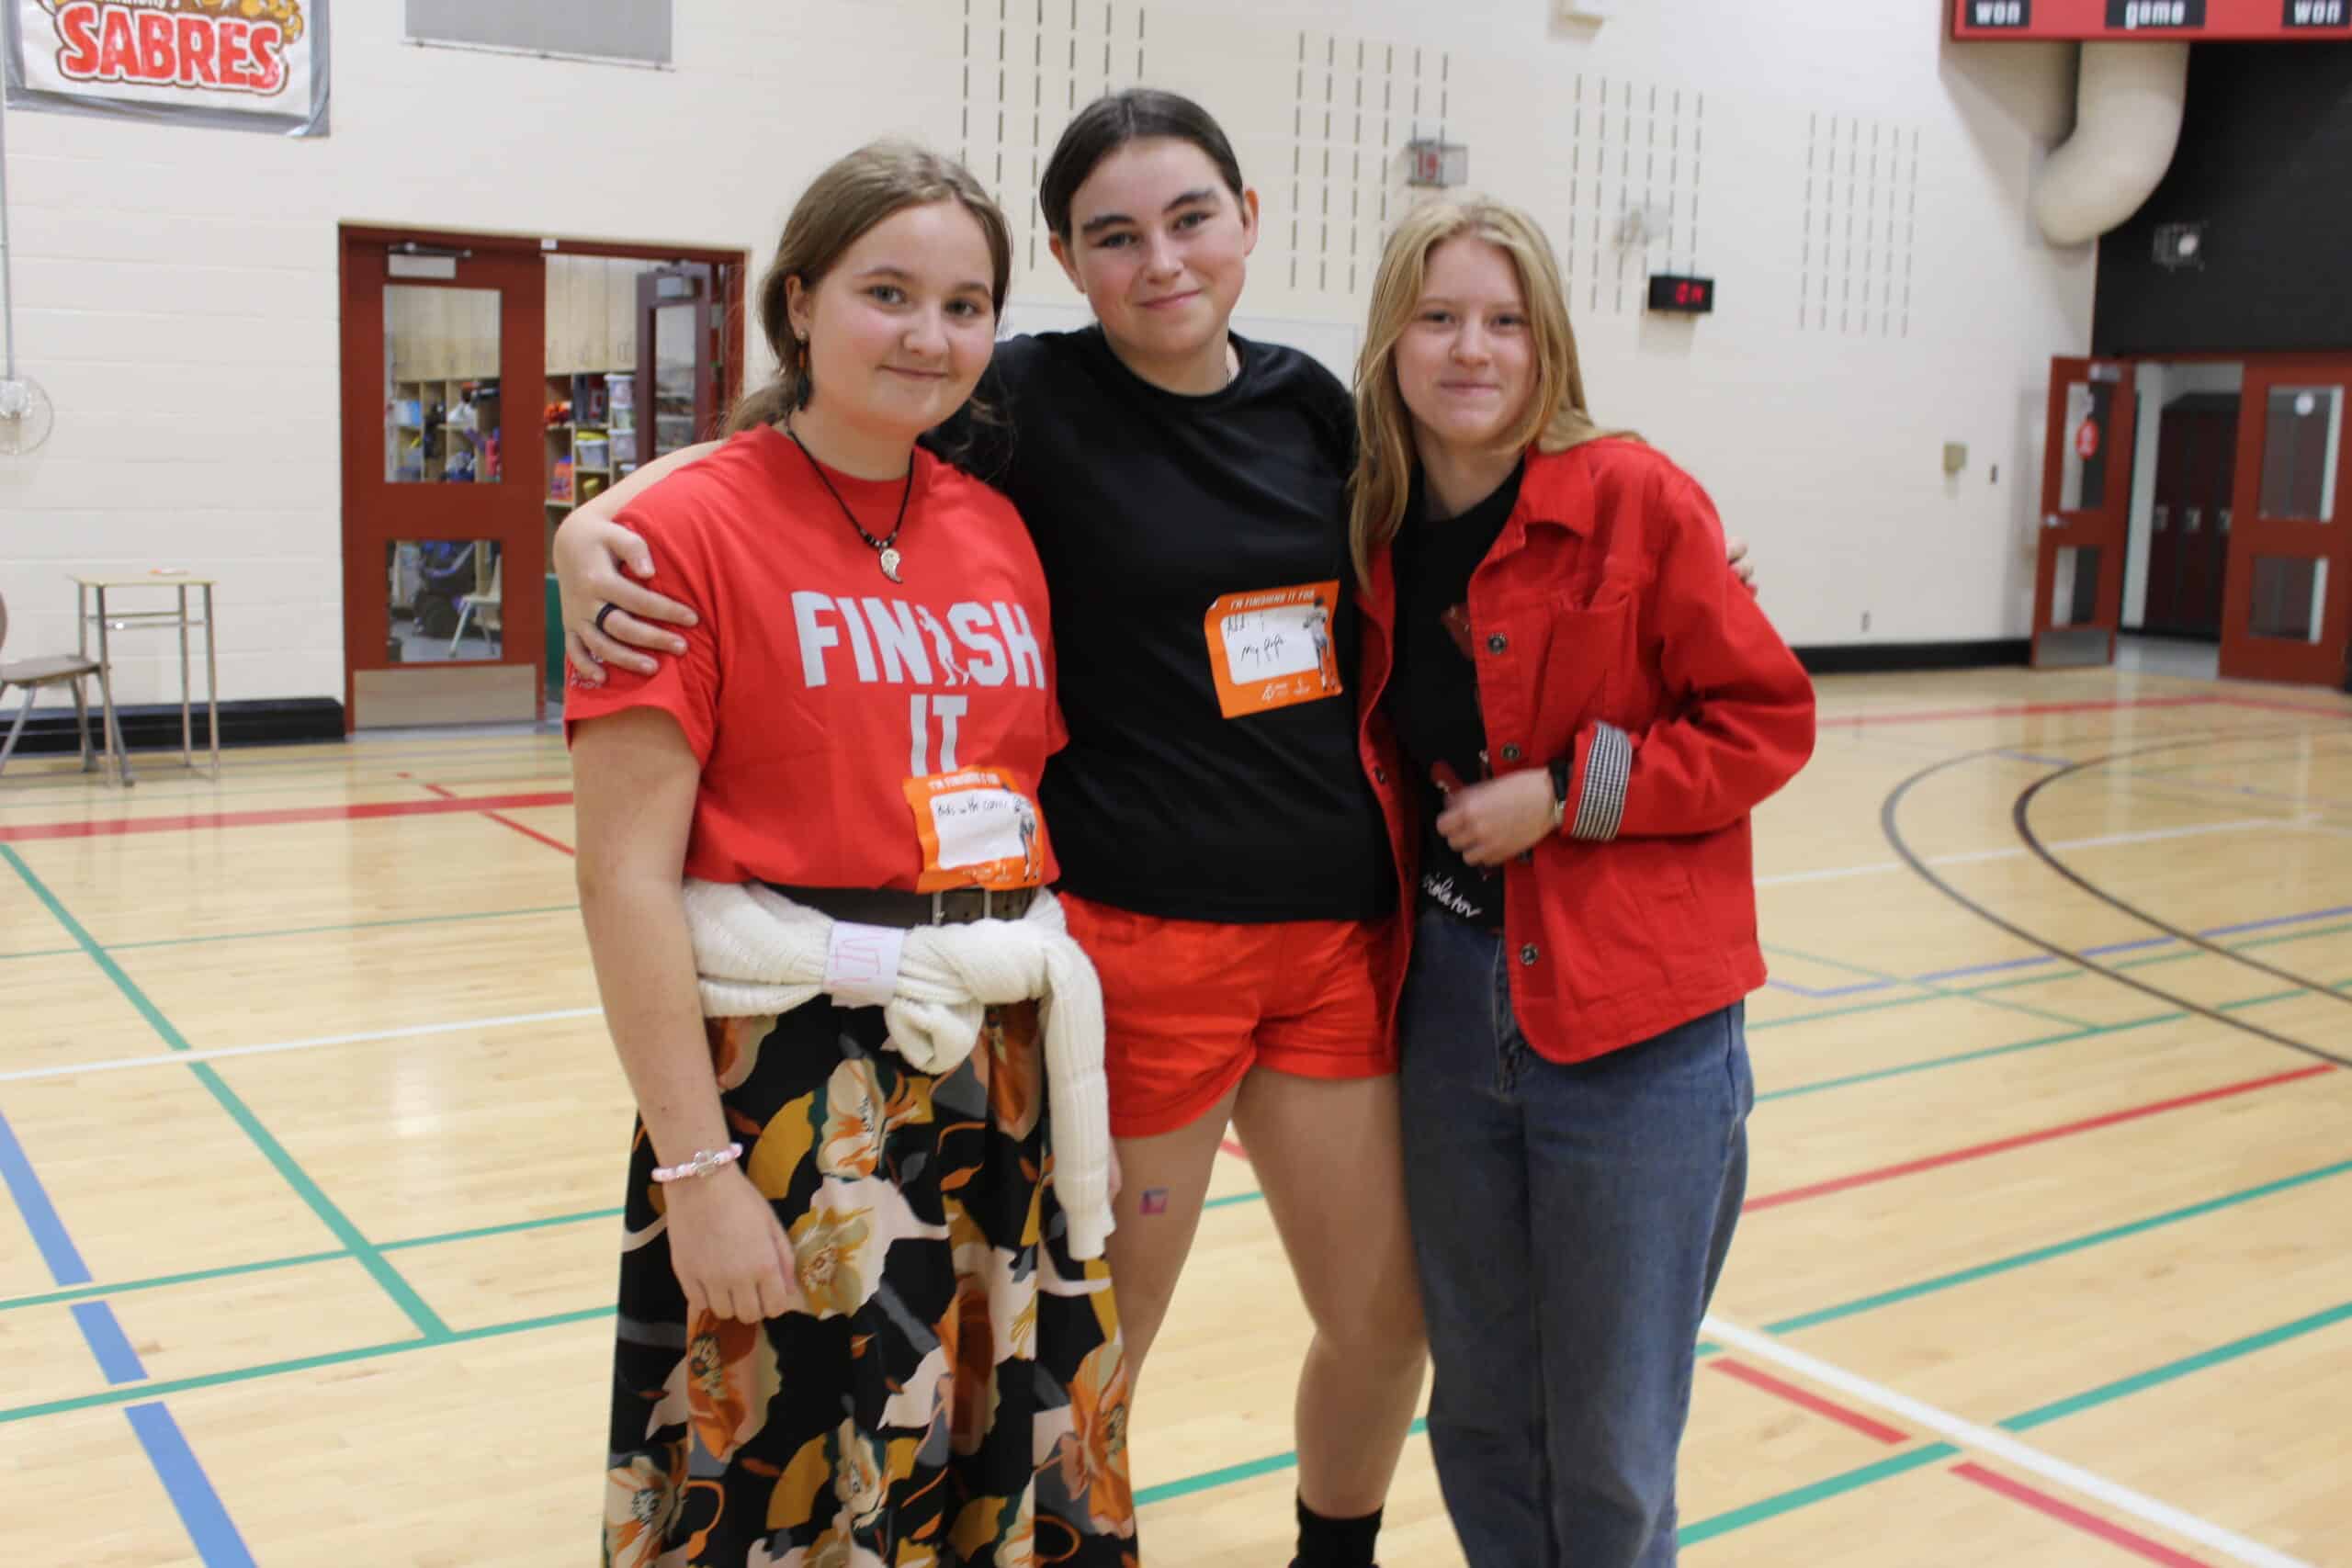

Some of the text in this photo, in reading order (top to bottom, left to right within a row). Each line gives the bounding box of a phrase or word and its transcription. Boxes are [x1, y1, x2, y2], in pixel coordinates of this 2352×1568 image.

[1976, 0, 2020, 25] won
[2124, 0, 2185, 29] game
[2294, 0, 2341, 25] won
[61, 5, 283, 92] SABRES
[910, 694, 968, 779] IT
